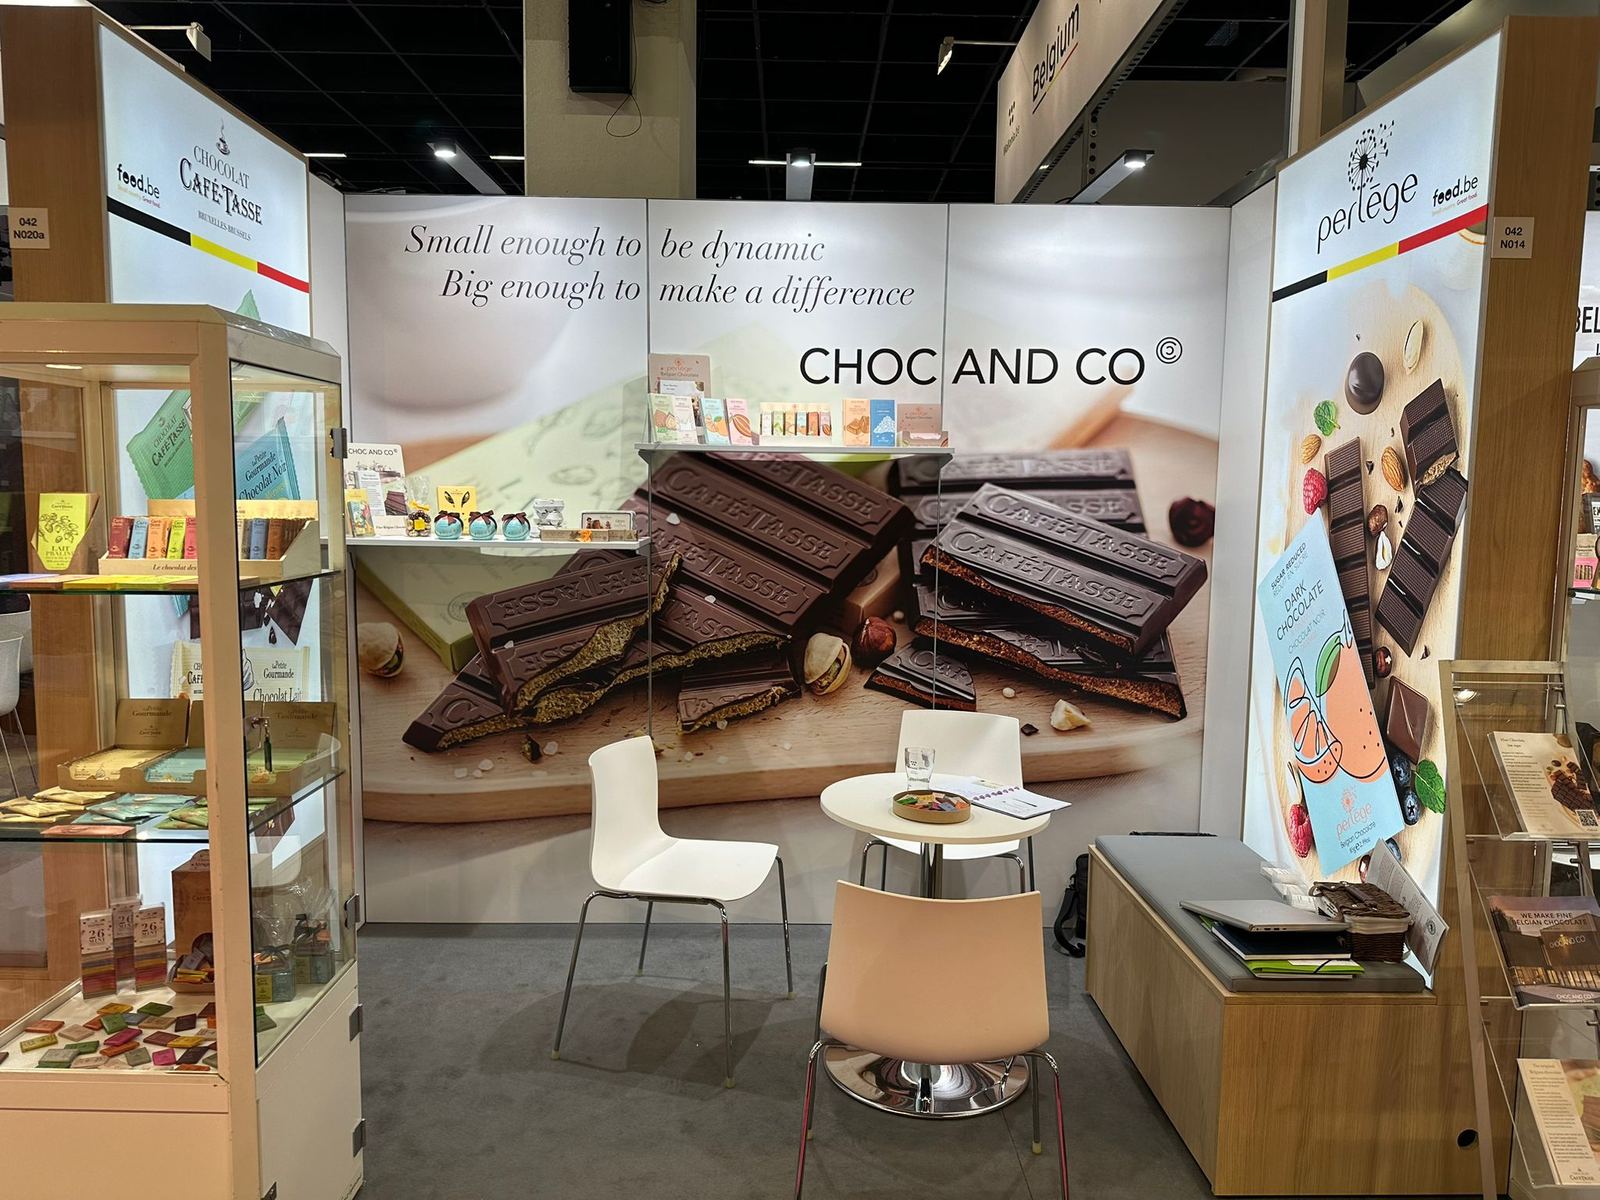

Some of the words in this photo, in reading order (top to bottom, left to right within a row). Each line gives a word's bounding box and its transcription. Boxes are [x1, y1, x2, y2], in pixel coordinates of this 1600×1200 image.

[1032, 2, 1080, 102] Belgium
[117, 163, 160, 199] food.be
[194, 145, 249, 189] CHOCOLAT
[1432, 175, 1479, 207] food.be
[13, 230, 45, 240] N020a
[19, 217, 38, 227] 042
[1504, 226, 1523, 236] 042
[404, 224, 494, 255] Small
[500, 227, 606, 266] enough
[615, 235, 642, 257] to
[660, 228, 694, 259] be
[701, 229, 825, 269] dynamic
[1500, 239, 1526, 249] N014
[439, 269, 494, 308] Big
[500, 270, 606, 309] enough
[615, 279, 641, 301] to
[658, 274, 738, 304] make
[746, 285, 763, 304] a
[772, 274, 916, 313] difference
[800, 347, 938, 386] CHOC
[951, 347, 1060, 386] AND
[1076, 347, 1146, 386] CO
[245, 452, 277, 482] Gourmande
[347, 448, 368, 456] CHOC
[239, 474, 272, 500] Chocolat
[1271, 568, 1286, 590] SUGAR
[1286, 542, 1306, 570] REDUCED
[1276, 579, 1324, 641] CHOCOLATE
[1284, 579, 1307, 613] DARK
[263, 667, 295, 679] Gourmande
[253, 687, 288, 702] Chocolat
[88, 929, 105, 939] 26
[141, 922, 158, 932] 26
